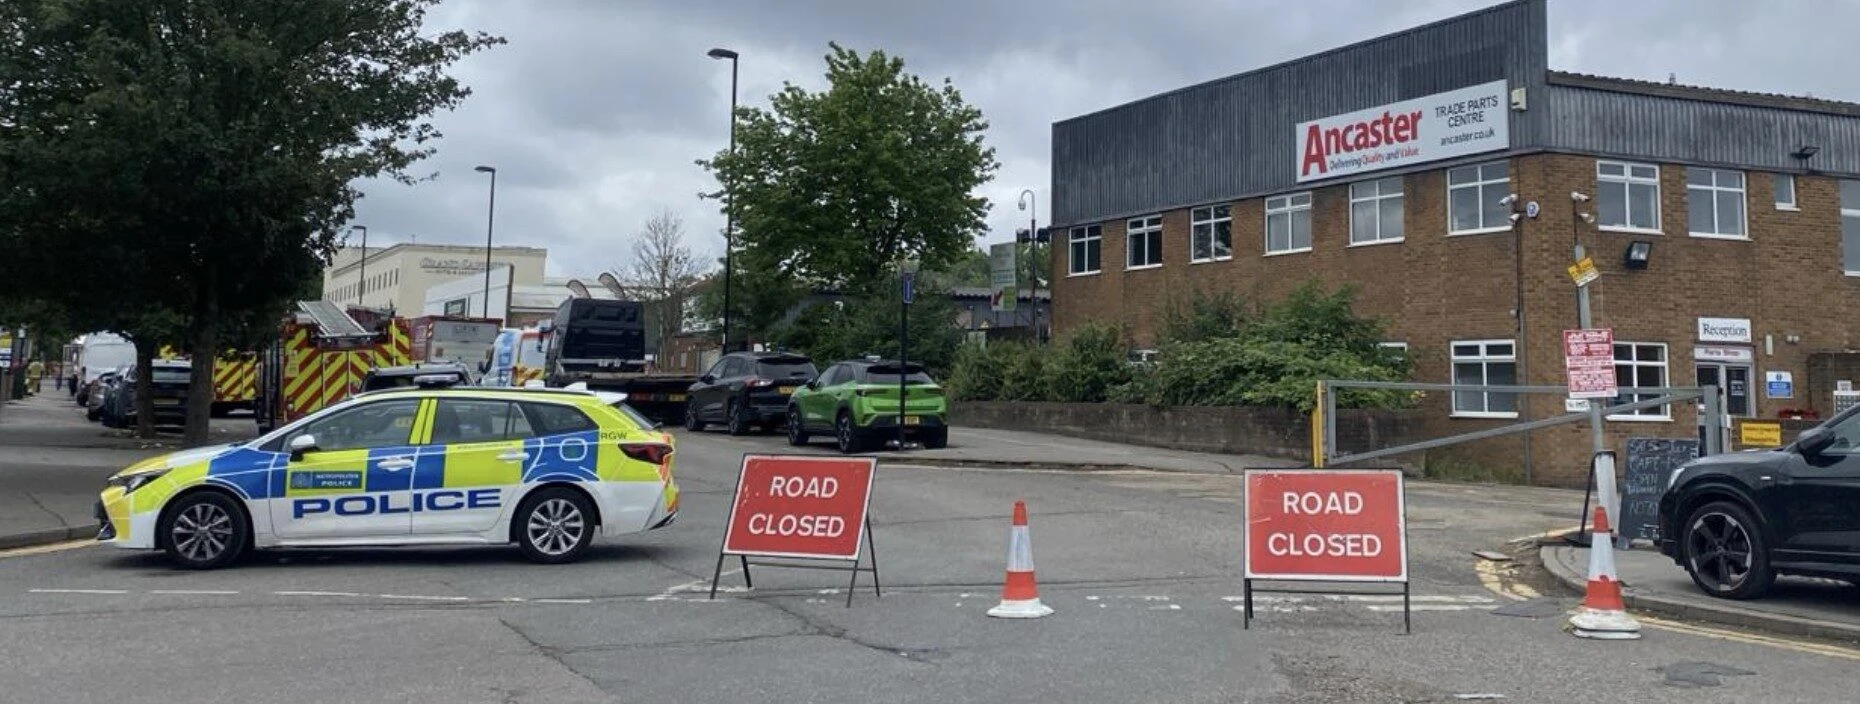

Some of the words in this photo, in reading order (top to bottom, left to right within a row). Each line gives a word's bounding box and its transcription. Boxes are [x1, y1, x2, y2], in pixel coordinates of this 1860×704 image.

[1435, 100, 1465, 117] TRADE
[1467, 95, 1498, 111] PARTS
[1448, 111, 1485, 127] CENTRE
[1302, 110, 1422, 176] Ancaster
[1441, 128, 1494, 146] ancaster.co.uk
[1330, 153, 1362, 170] Delivering
[1362, 150, 1385, 166] Quality
[1385, 149, 1399, 161] and
[1399, 146, 1420, 159] Value
[1703, 324, 1748, 337] Reception
[601, 431, 628, 440] RGW
[770, 475, 839, 498] ROAD
[293, 488, 502, 519] POLICE
[1281, 492, 1364, 514] ROAD
[748, 513, 845, 538] CLOSED
[1267, 534, 1383, 557] CLOSED
